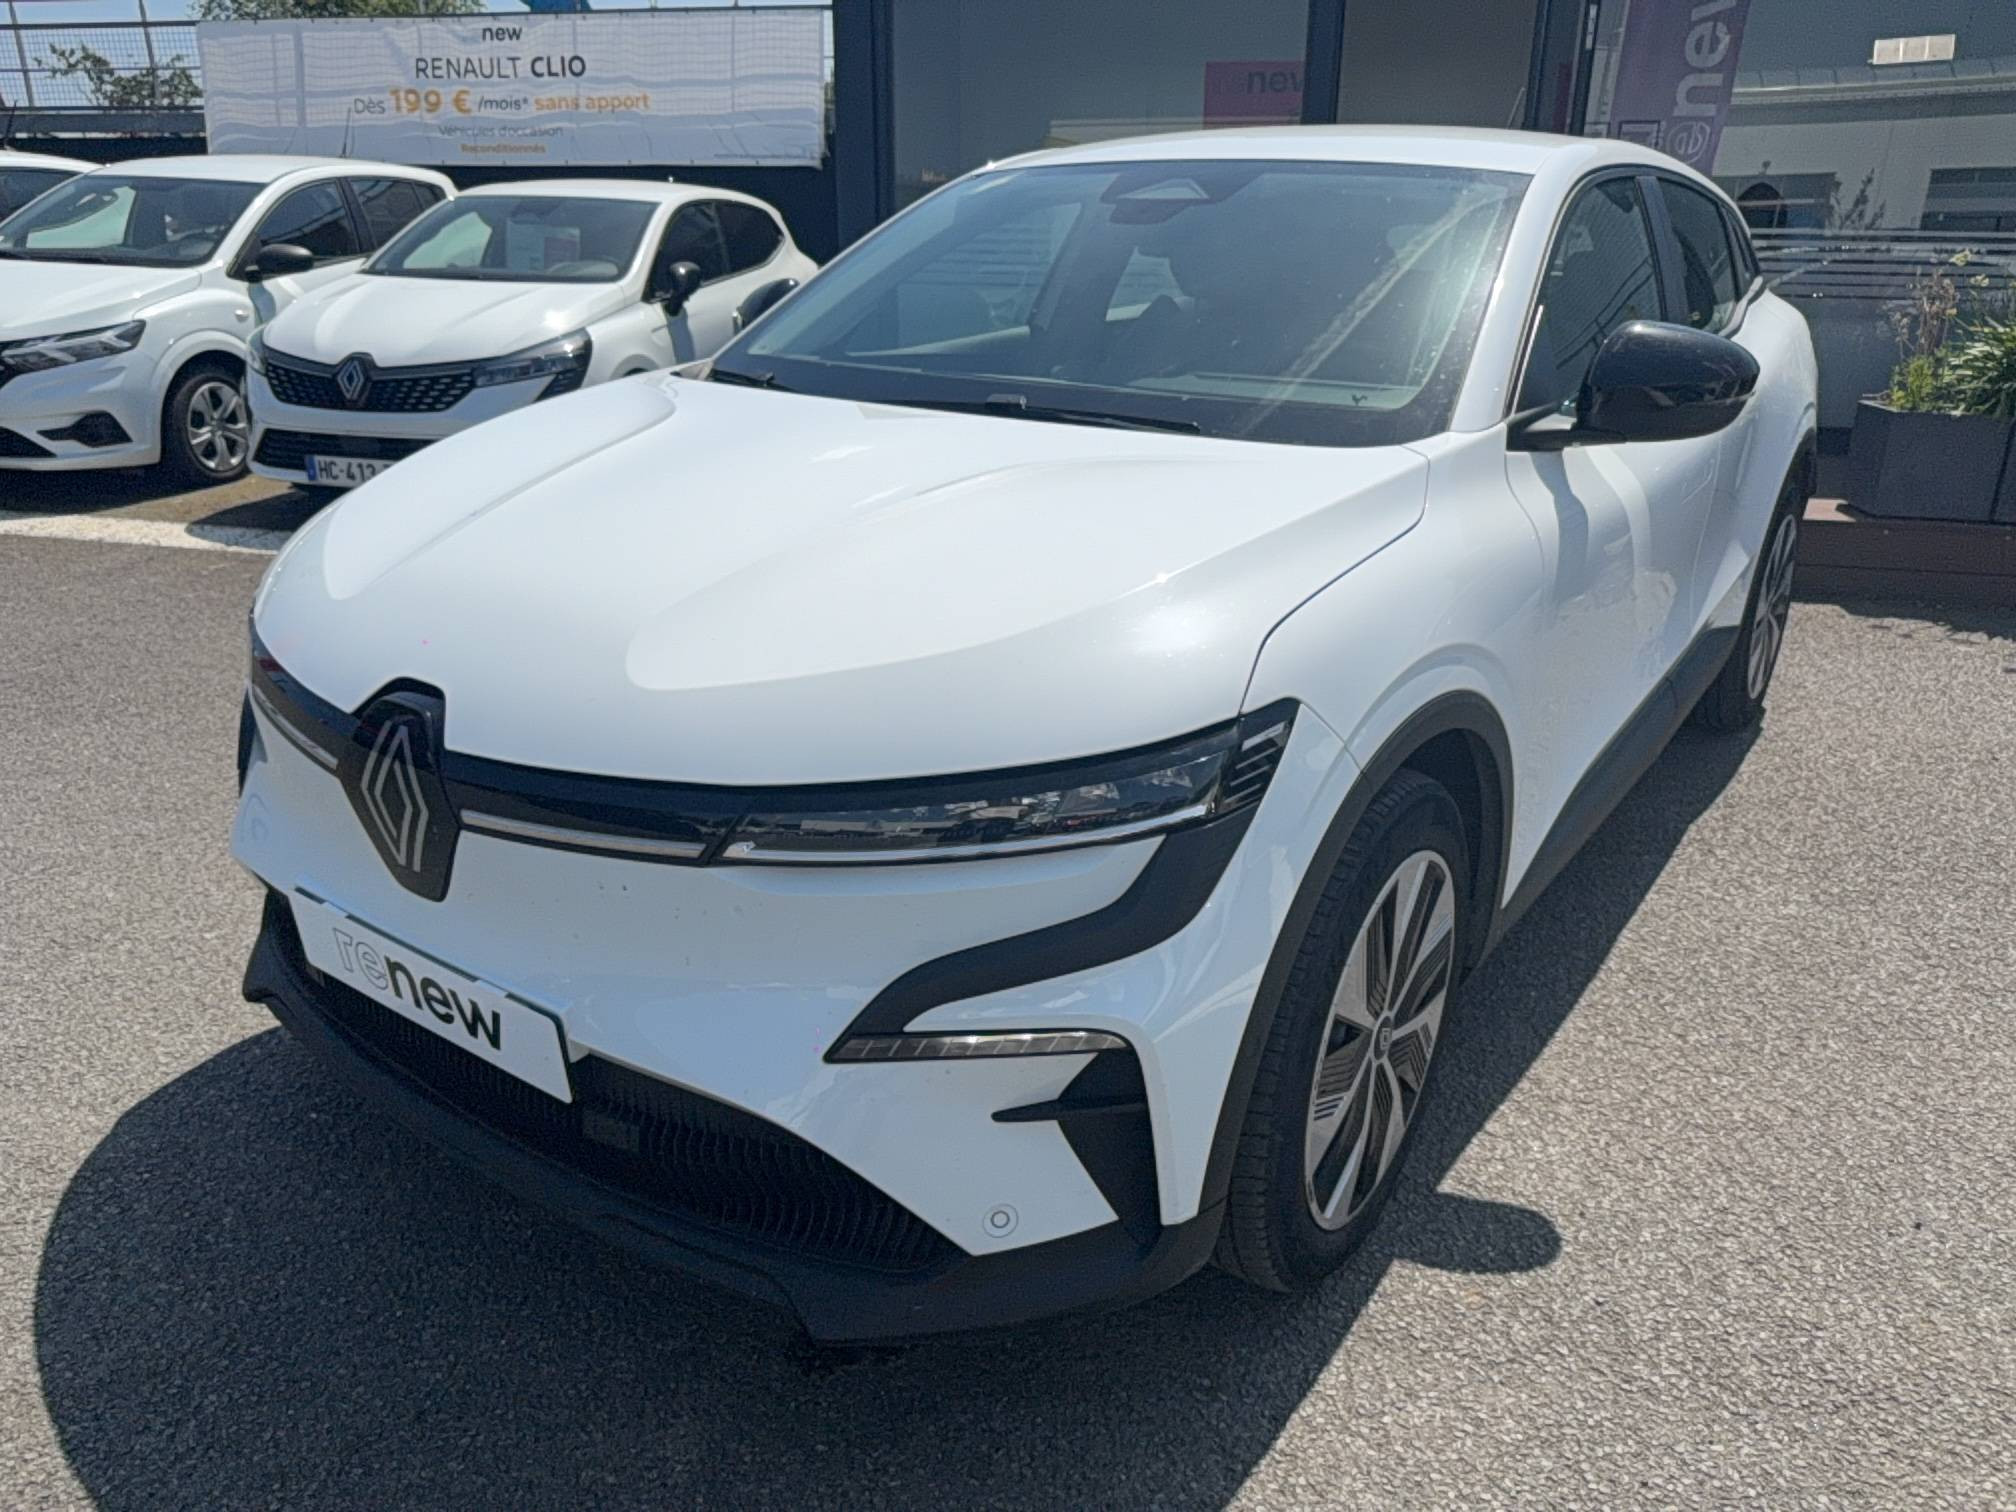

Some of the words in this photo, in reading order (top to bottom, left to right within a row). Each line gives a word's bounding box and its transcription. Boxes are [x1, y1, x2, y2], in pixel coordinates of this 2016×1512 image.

[482, 27, 523, 41] new
[415, 57, 520, 79] RENAULT
[530, 56, 586, 78] CLIO
[353, 97, 386, 115] Dès
[389, 88, 442, 114] 199
[452, 89, 473, 114] €
[533, 97, 580, 112] sans
[585, 93, 650, 114] apport
[318, 460, 391, 481] HC-413
[332, 926, 501, 1051] renew
